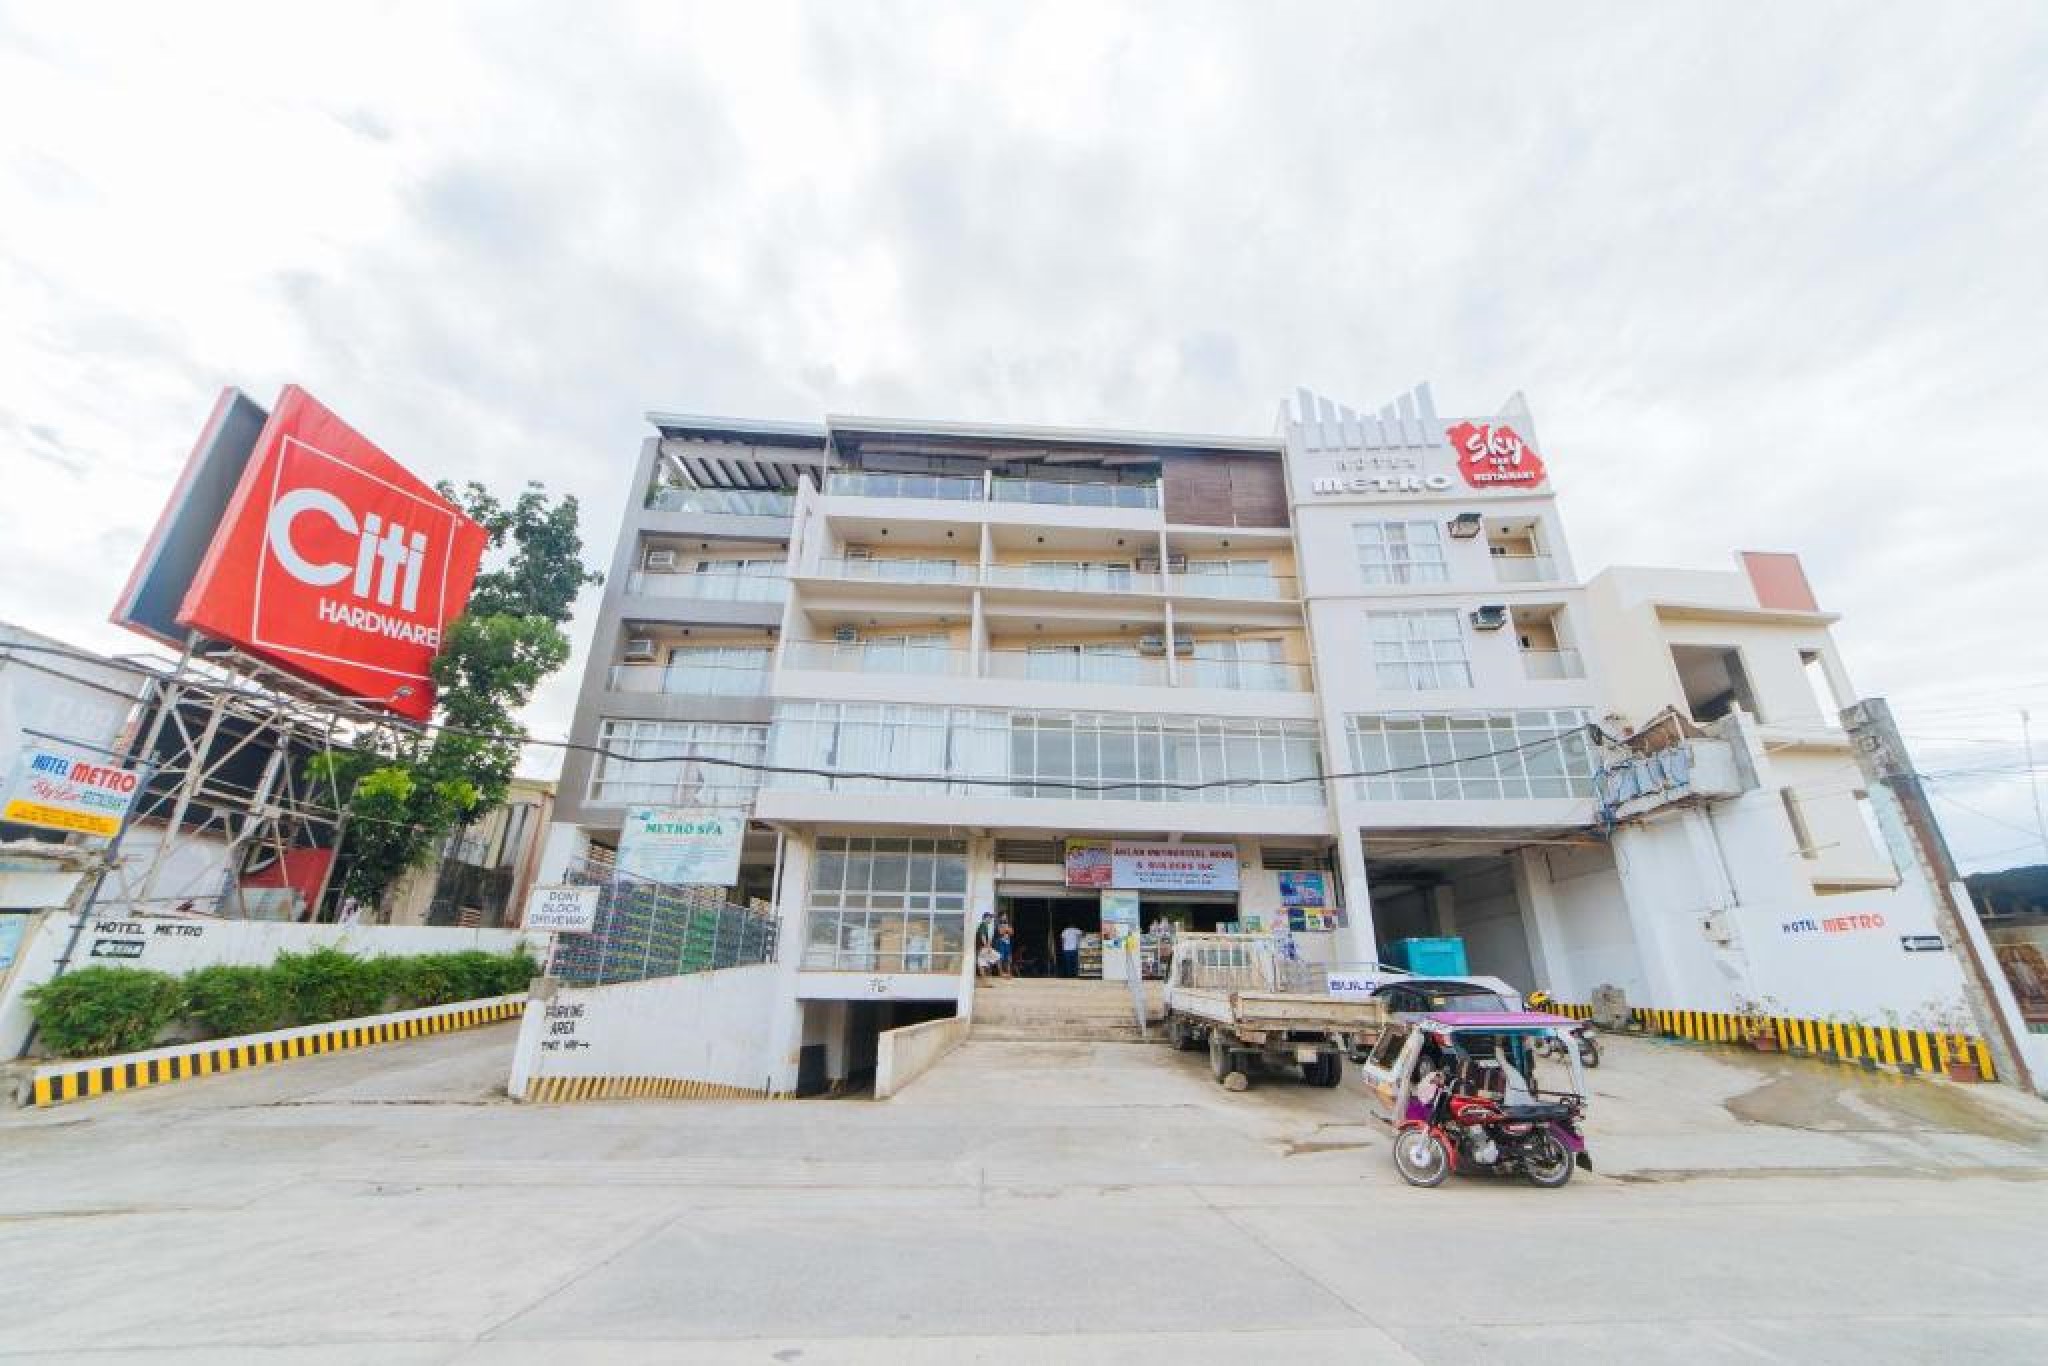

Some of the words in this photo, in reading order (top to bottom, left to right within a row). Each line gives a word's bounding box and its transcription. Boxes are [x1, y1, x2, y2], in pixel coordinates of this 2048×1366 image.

[1465, 427, 1522, 465] Sky
[1312, 468, 1451, 495] METRO
[268, 489, 429, 613] Citi
[319, 596, 440, 648] HARDWARE
[31, 753, 69, 776] HOTEL
[69, 761, 137, 793] METRO
[645, 822, 695, 835] METRO
[697, 819, 723, 836] SPA
[94, 921, 144, 935] HOTEL
[154, 925, 203, 938] METRO
[1781, 918, 1819, 935] HOTEL
[1822, 913, 1886, 933] METRO
[550, 1021, 575, 1036] AREA
